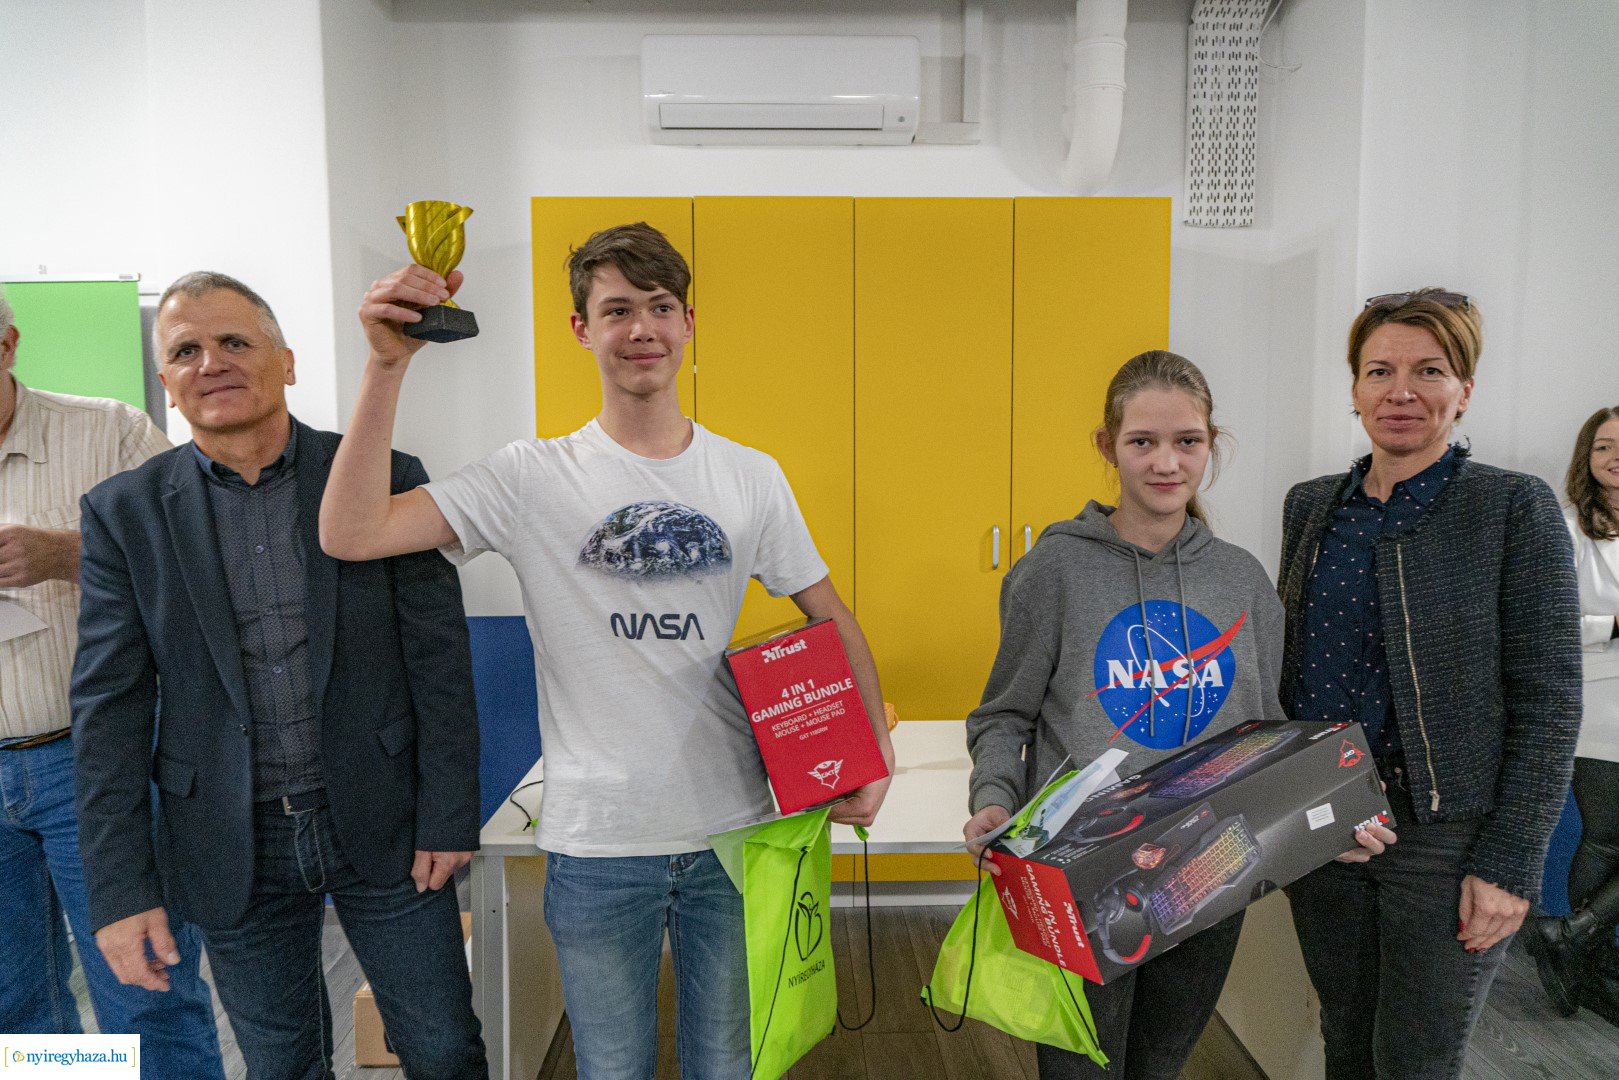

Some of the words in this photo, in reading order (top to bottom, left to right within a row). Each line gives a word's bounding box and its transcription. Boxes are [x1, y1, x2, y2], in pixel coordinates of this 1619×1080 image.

[610, 612, 705, 640] NASA
[771, 638, 808, 660] Trust
[781, 688, 790, 698] 4
[790, 682, 806, 696] IN
[807, 678, 815, 689] 1
[1106, 658, 1225, 690] NASA
[751, 696, 803, 723] GAMING
[803, 677, 853, 704] BUNDLE
[771, 713, 808, 732] KEYBOARD
[813, 700, 844, 716] HEADSET
[774, 724, 800, 739] MOUSE
[805, 713, 831, 728] MOUSE
[831, 707, 846, 718] PAD
[1025, 864, 1048, 914] GAMING
[1044, 917, 1068, 968] BUNDLE
